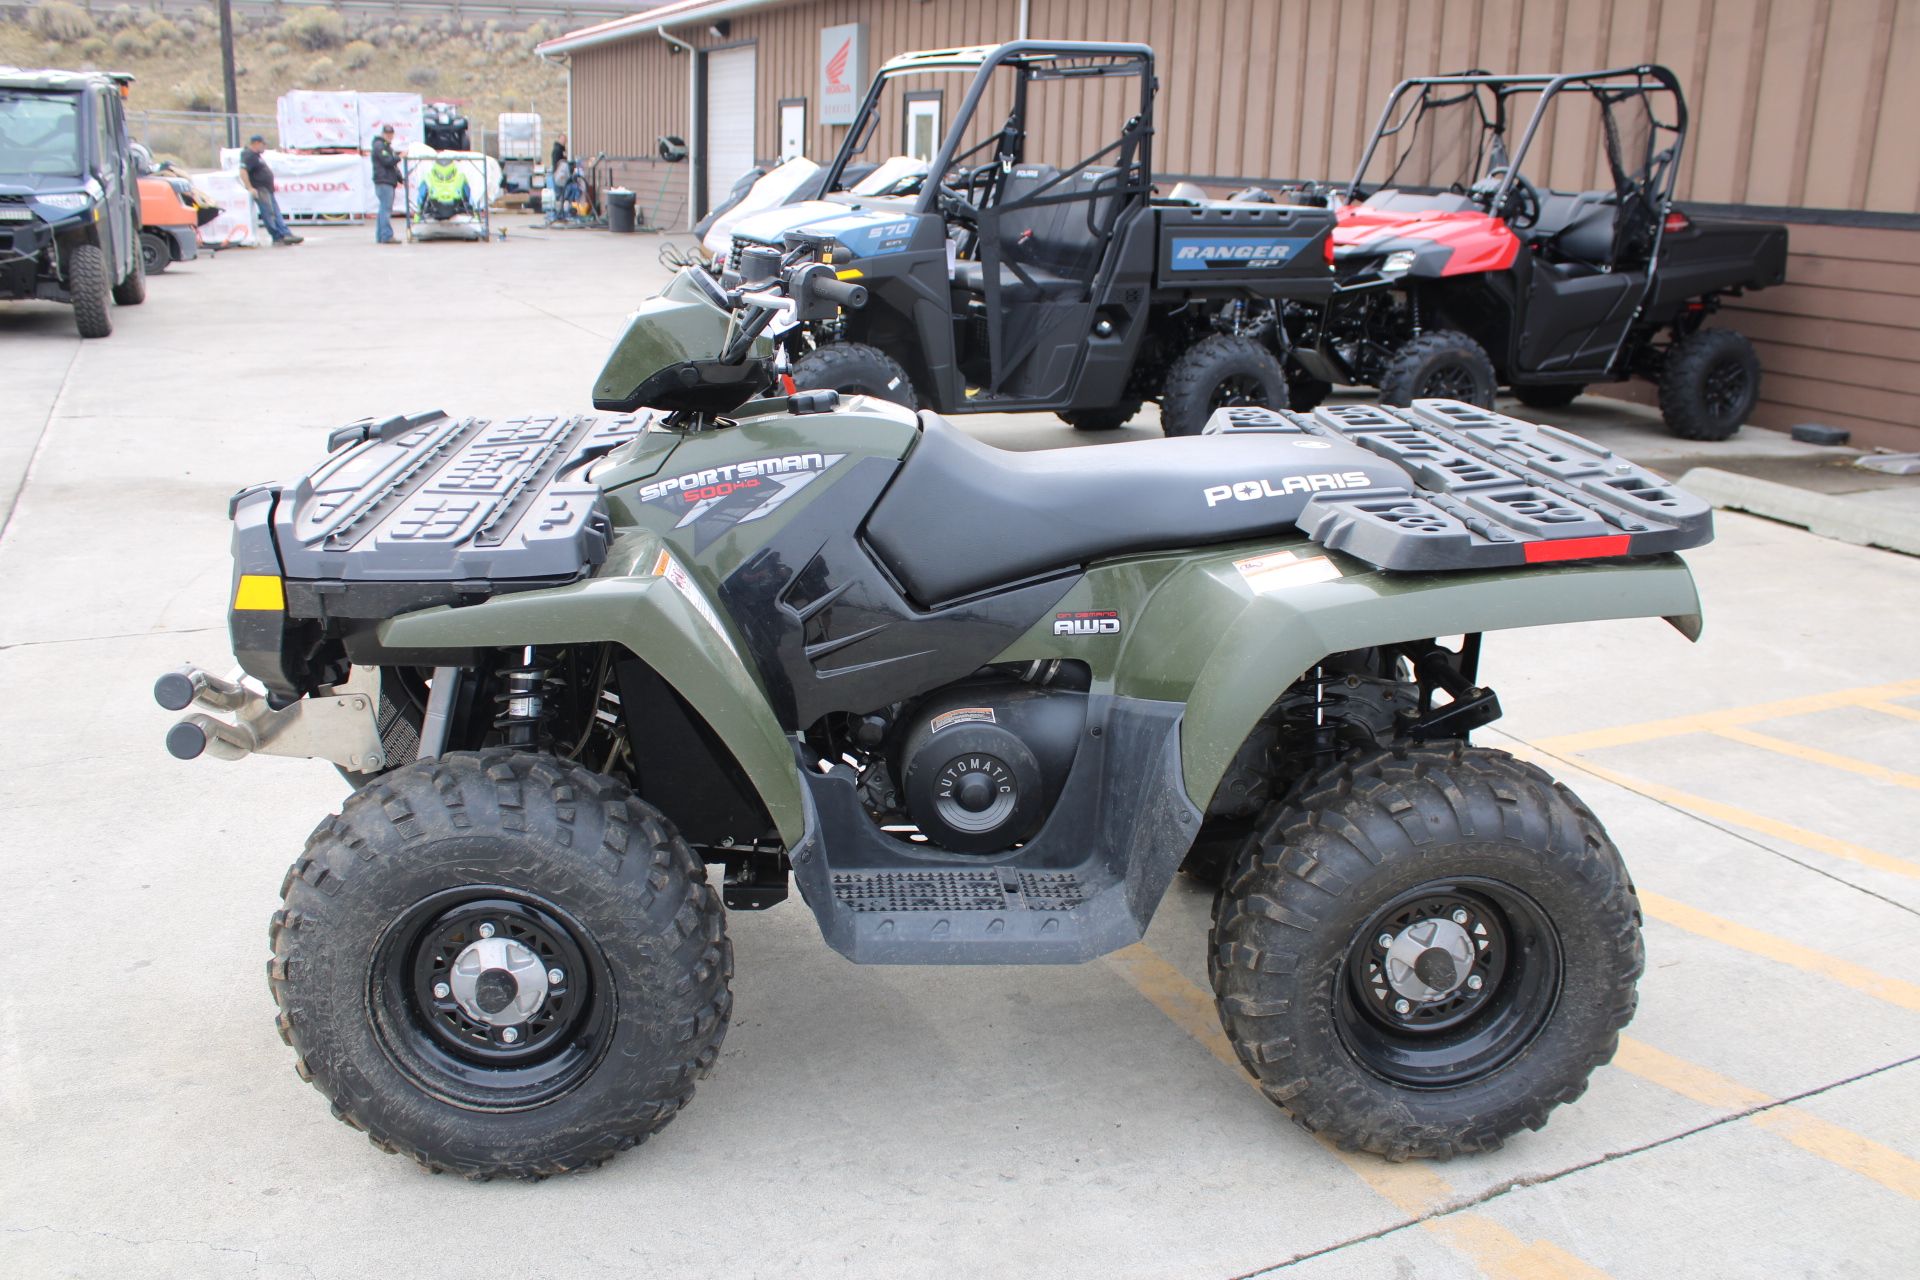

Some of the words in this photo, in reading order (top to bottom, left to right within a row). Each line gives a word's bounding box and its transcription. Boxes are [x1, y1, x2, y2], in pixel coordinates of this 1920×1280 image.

[868, 222, 910, 238] 570
[1177, 245, 1290, 260] RANGER
[1246, 259, 1280, 268] SP
[639, 453, 823, 502] SPORTSMAN
[683, 482, 734, 502] 500
[1204, 471, 1371, 507] POLARIS
[1054, 618, 1121, 635] AWD
[939, 758, 1011, 798] AUTOMATIC
